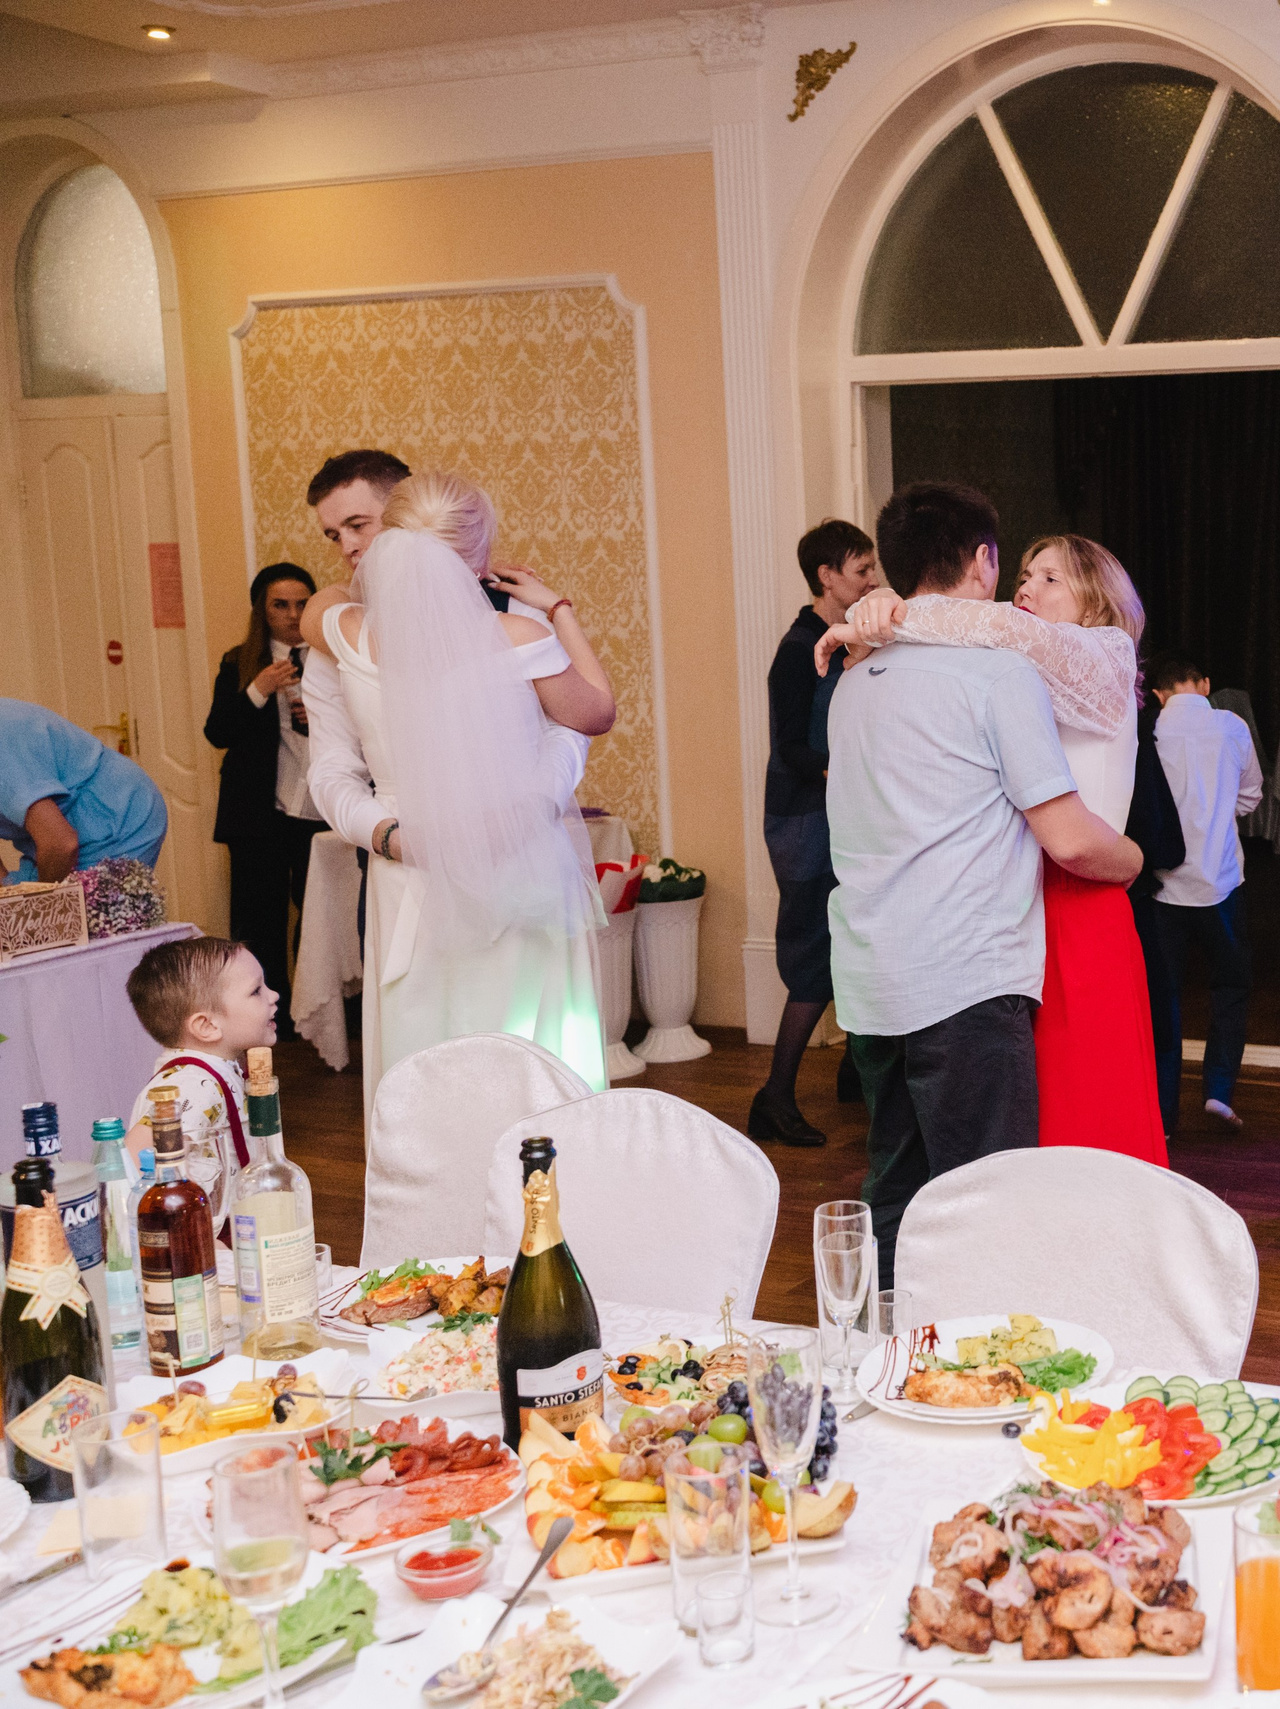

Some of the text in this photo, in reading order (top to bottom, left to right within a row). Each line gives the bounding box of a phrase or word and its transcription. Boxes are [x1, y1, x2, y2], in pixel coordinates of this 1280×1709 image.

[8, 901, 74, 937] Wedding
[60, 1197, 99, 1227] АСКИ
[534, 1392, 575, 1408] SANTO
[562, 1401, 599, 1422] BIANCO
